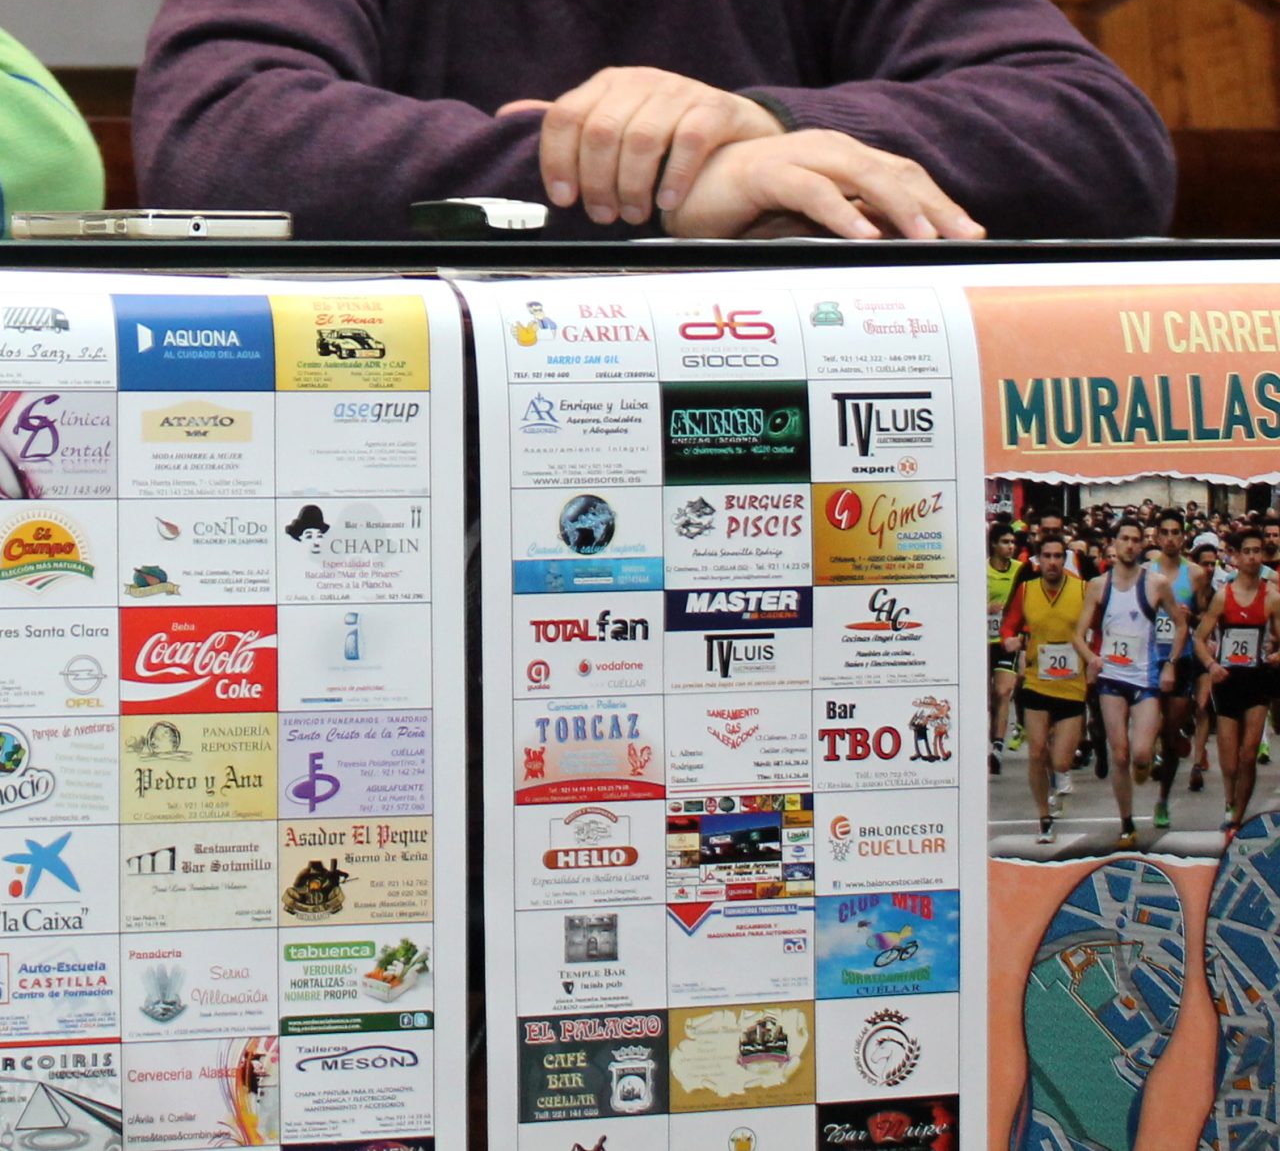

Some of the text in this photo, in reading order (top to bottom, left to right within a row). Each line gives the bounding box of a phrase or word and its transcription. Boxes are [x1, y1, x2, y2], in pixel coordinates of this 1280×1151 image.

[579, 304, 626, 319] BAR
[562, 325, 650, 343] GARITA
[907, 319, 938, 338] Polo
[1120, 311, 1150, 353] IV
[163, 329, 240, 347] AQUONA
[237, 350, 261, 359] AGUA
[547, 356, 581, 364] BARRIO
[584, 356, 601, 364] SAN
[334, 402, 419, 422] asegrup
[560, 399, 648, 413] Enrique y Luisa
[999, 370, 1280, 450] MURALLAS
[875, 409, 933, 432] LUIS
[20, 421, 111, 459] Dental
[724, 494, 804, 510] BURGUER
[727, 515, 802, 538] PISCIS
[868, 491, 943, 549] Gómez
[4, 538, 75, 561] Campo
[330, 538, 419, 554] CHAPLIN
[897, 542, 942, 550] DEPORTES
[2, 564, 34, 576] ELECCIÓN
[53, 562, 87, 572] NATURAL
[686, 590, 798, 613] MASTER
[25, 625, 64, 638] Santa
[71, 624, 109, 637] Clara
[172, 622, 195, 631] Beba
[1156, 618, 1171, 632] 25
[733, 646, 774, 661] LUIS
[1232, 641, 1247, 654] 26
[596, 661, 643, 671] vodafone
[1050, 656, 1067, 668] 20
[216, 679, 262, 698] Coke
[65, 699, 104, 708] OPEL
[826, 701, 856, 719] Bar
[32, 729, 59, 740] Parque
[62, 726, 72, 737] de
[202, 726, 270, 736] PANADERÍA
[287, 726, 425, 742] Santo Cristo de la Peña
[536, 714, 640, 743] TORCAZ
[725, 723, 741, 734] GAS
[201, 741, 272, 752] REPOSTERÍA
[819, 726, 902, 761] TBO
[135, 768, 196, 798] Pedro
[205, 776, 215, 795] y
[220, 766, 263, 796] Ana
[285, 825, 428, 848] Asador El Peque
[859, 824, 943, 837] BALONCESTO
[858, 838, 946, 857] CUELLAR
[345, 854, 380, 863] Horno
[385, 853, 396, 862] de
[557, 850, 625, 867] HELIO
[182, 861, 205, 873] Bar
[839, 892, 933, 923] CLUB MTB
[289, 944, 370, 959] tabuenca
[19, 962, 106, 974] Auto-Escuela
[303, 964, 352, 975] VERDURAS
[19, 976, 107, 989] CASTILLA
[13, 991, 44, 999] Centro
[64, 989, 113, 997] Formación
[284, 990, 357, 1001] NOMBRE PROPIO
[525, 1015, 662, 1043] EL PALACIO
[297, 1046, 348, 1054] Talleres
[322, 1055, 405, 1070] MESÓN
[543, 1051, 587, 1068] CAFÉ
[546, 1073, 584, 1089] BAR
